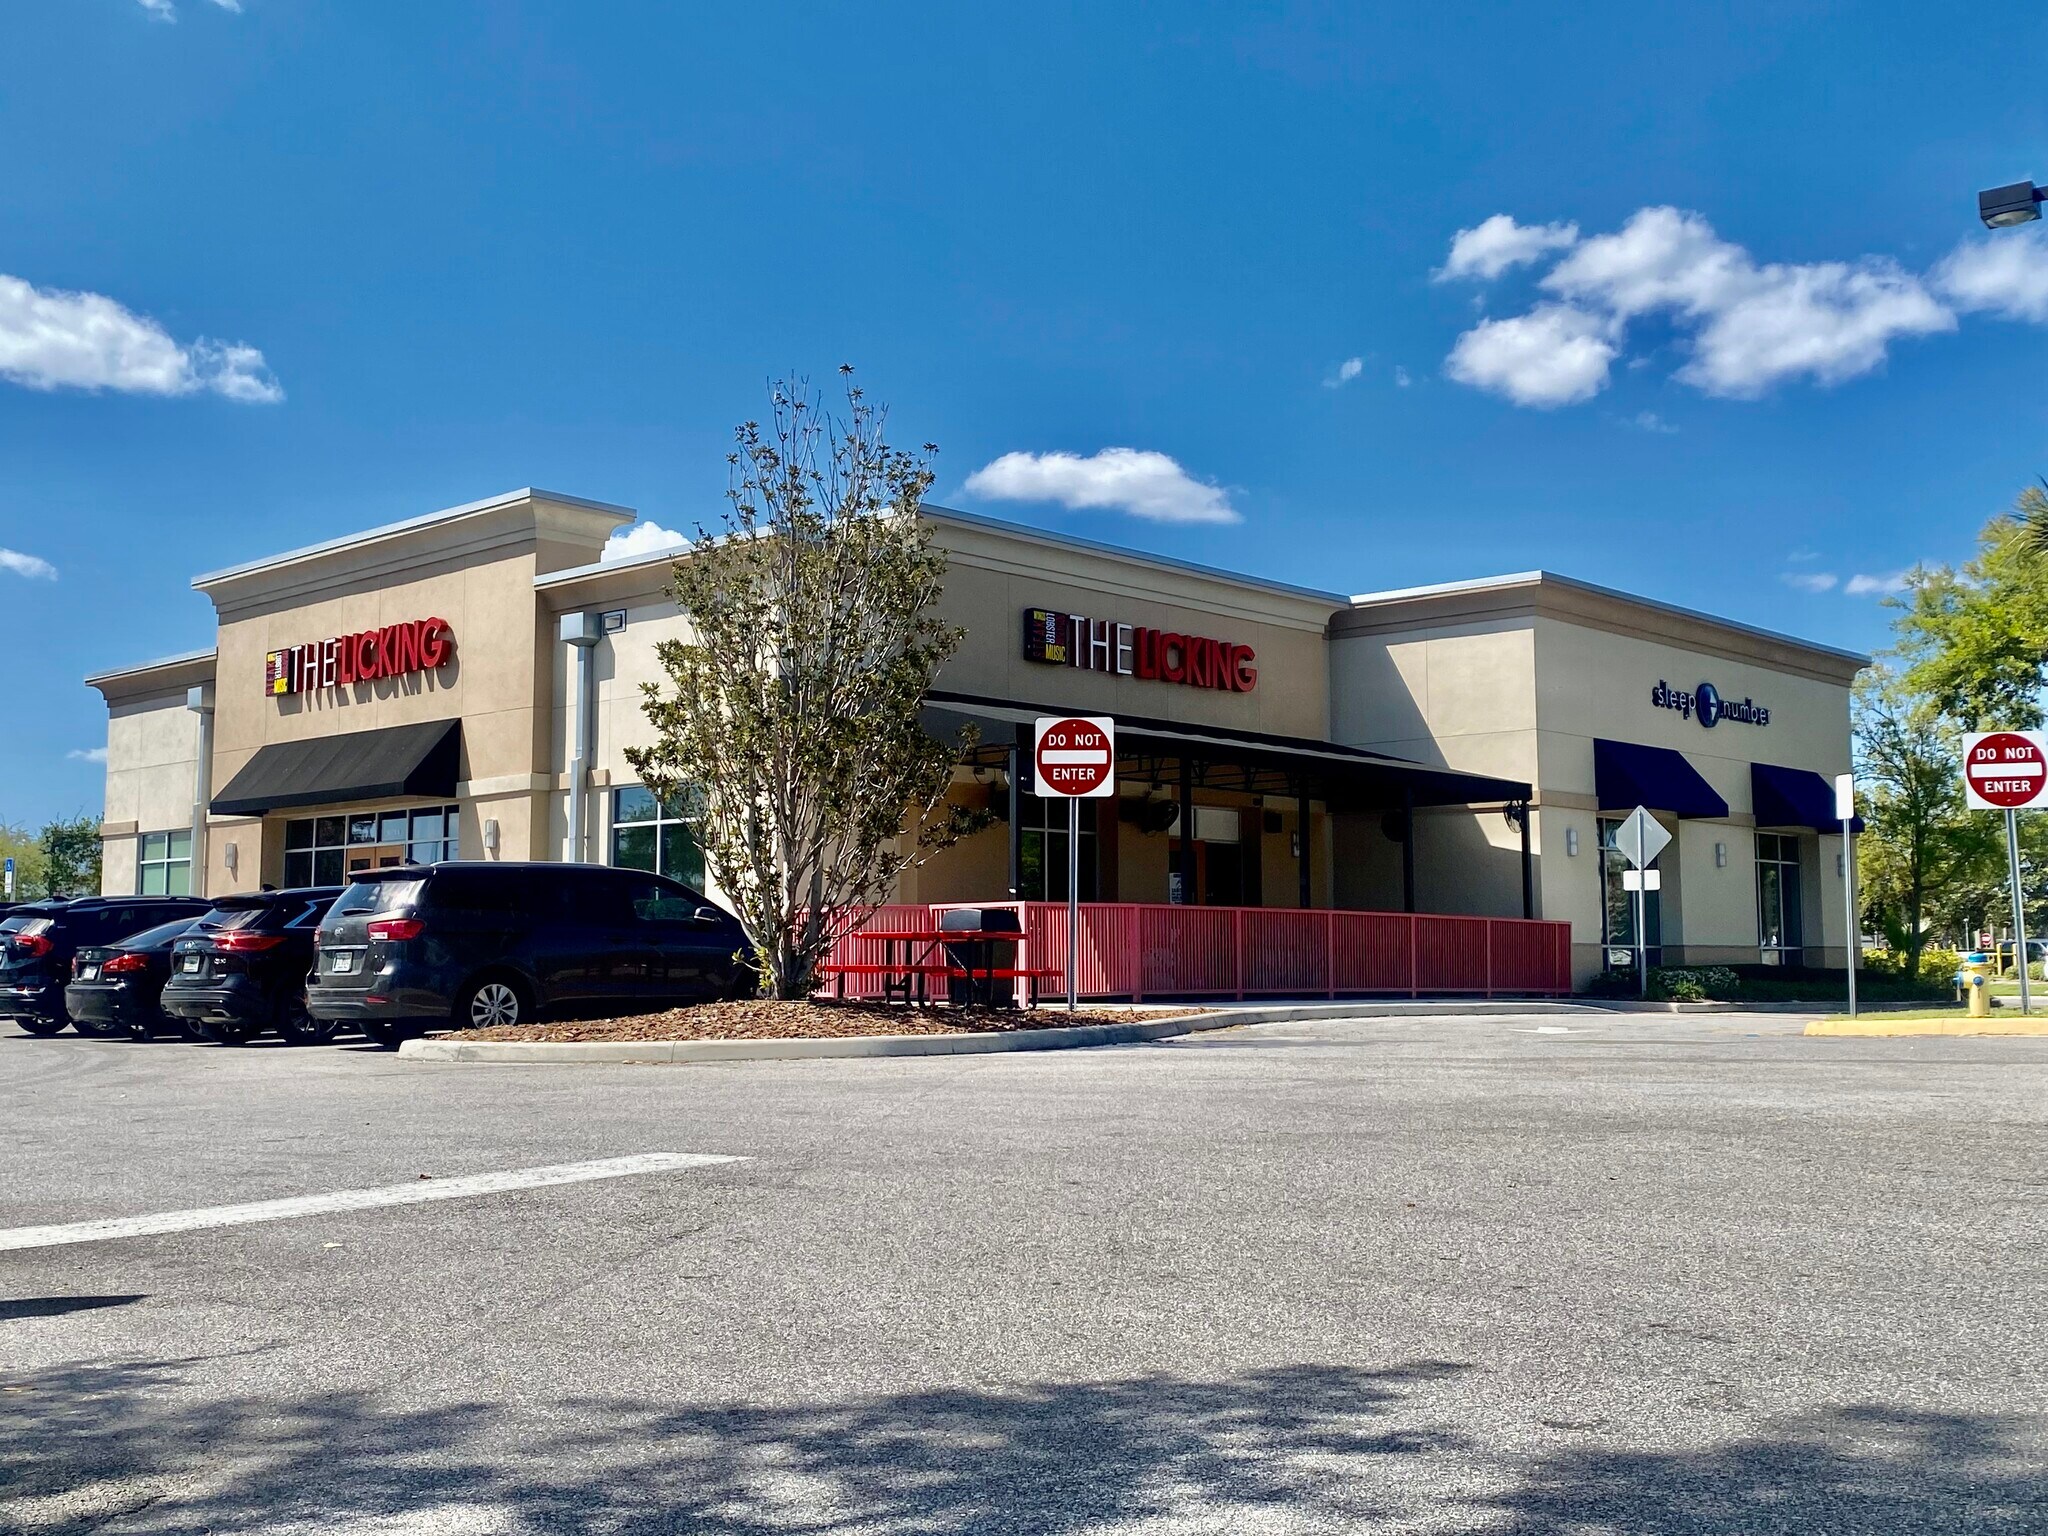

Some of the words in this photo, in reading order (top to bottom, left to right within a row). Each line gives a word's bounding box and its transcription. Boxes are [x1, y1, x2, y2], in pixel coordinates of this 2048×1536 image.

[1045, 612, 1056, 644] LOBSTER
[290, 636, 340, 693] THE
[340, 616, 449, 684] LICKING
[1045, 643, 1066, 662] MUSIC
[1069, 614, 1133, 675] THE
[1134, 627, 1258, 693] LICKING
[1652, 679, 1697, 720] sleep
[1048, 733, 1067, 746] DO
[1074, 733, 1102, 746] NOT
[1976, 747, 1997, 761] DO
[2005, 746, 2034, 760] NOT
[1052, 767, 1096, 780] ENTER
[1984, 779, 2032, 794] ENTER
